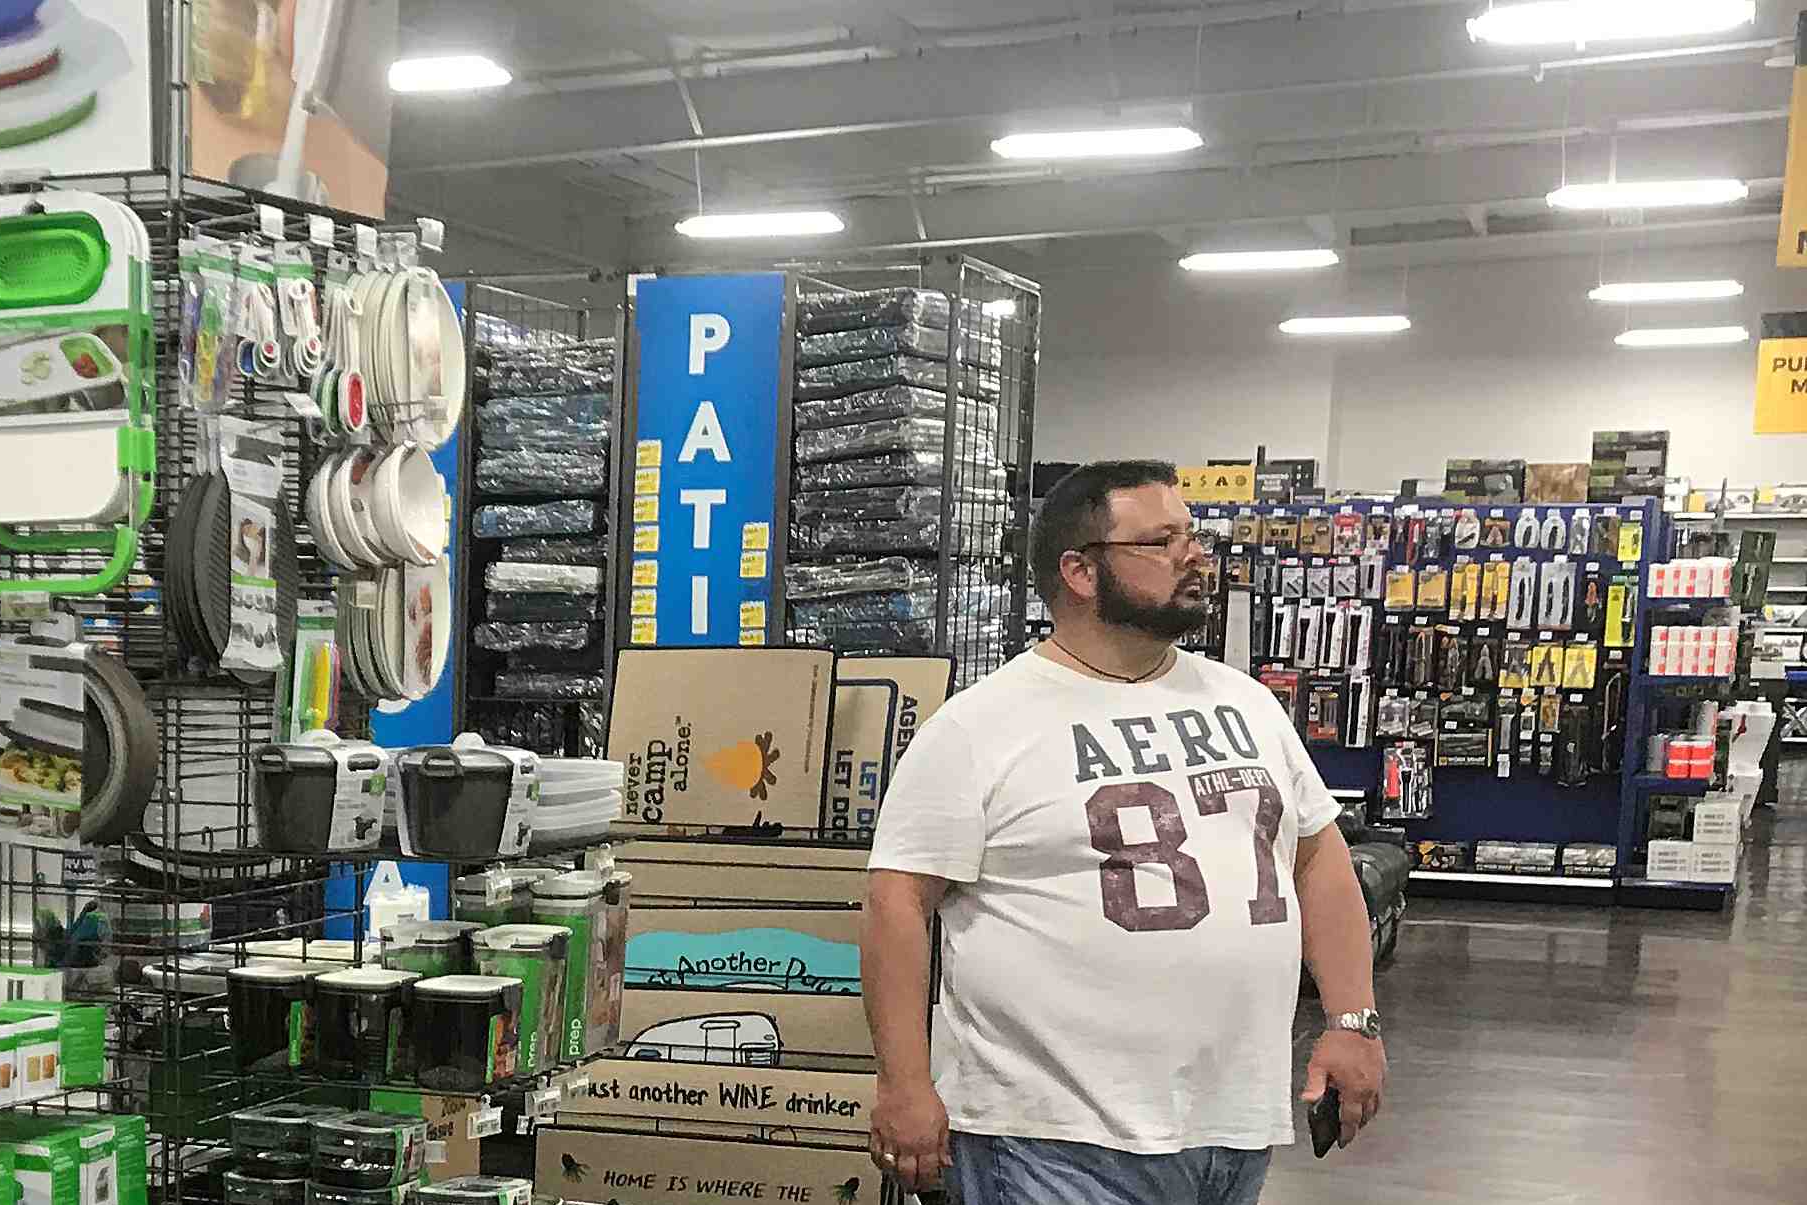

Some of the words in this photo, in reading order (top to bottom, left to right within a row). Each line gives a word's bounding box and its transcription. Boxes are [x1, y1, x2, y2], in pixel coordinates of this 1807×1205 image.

[1071, 705, 1259, 783] AERO
[625, 754, 642, 815] never
[642, 740, 673, 825] camp
[835, 750, 853, 789] LET
[859, 761, 878, 800] LET
[1193, 768, 1275, 798] ATHL-DEPT
[1085, 767, 1288, 932] 87
[678, 951, 781, 985] Another
[570, 1018, 582, 1056] prep
[586, 1079, 620, 1099] ust
[629, 1082, 709, 1107] another
[719, 1083, 777, 1110] WINE
[785, 1093, 862, 1118] drinker
[603, 1171, 657, 1190] HOME
[666, 1175, 689, 1193] IS
[696, 1180, 767, 1200] WHERE
[776, 1185, 813, 1204] THE
